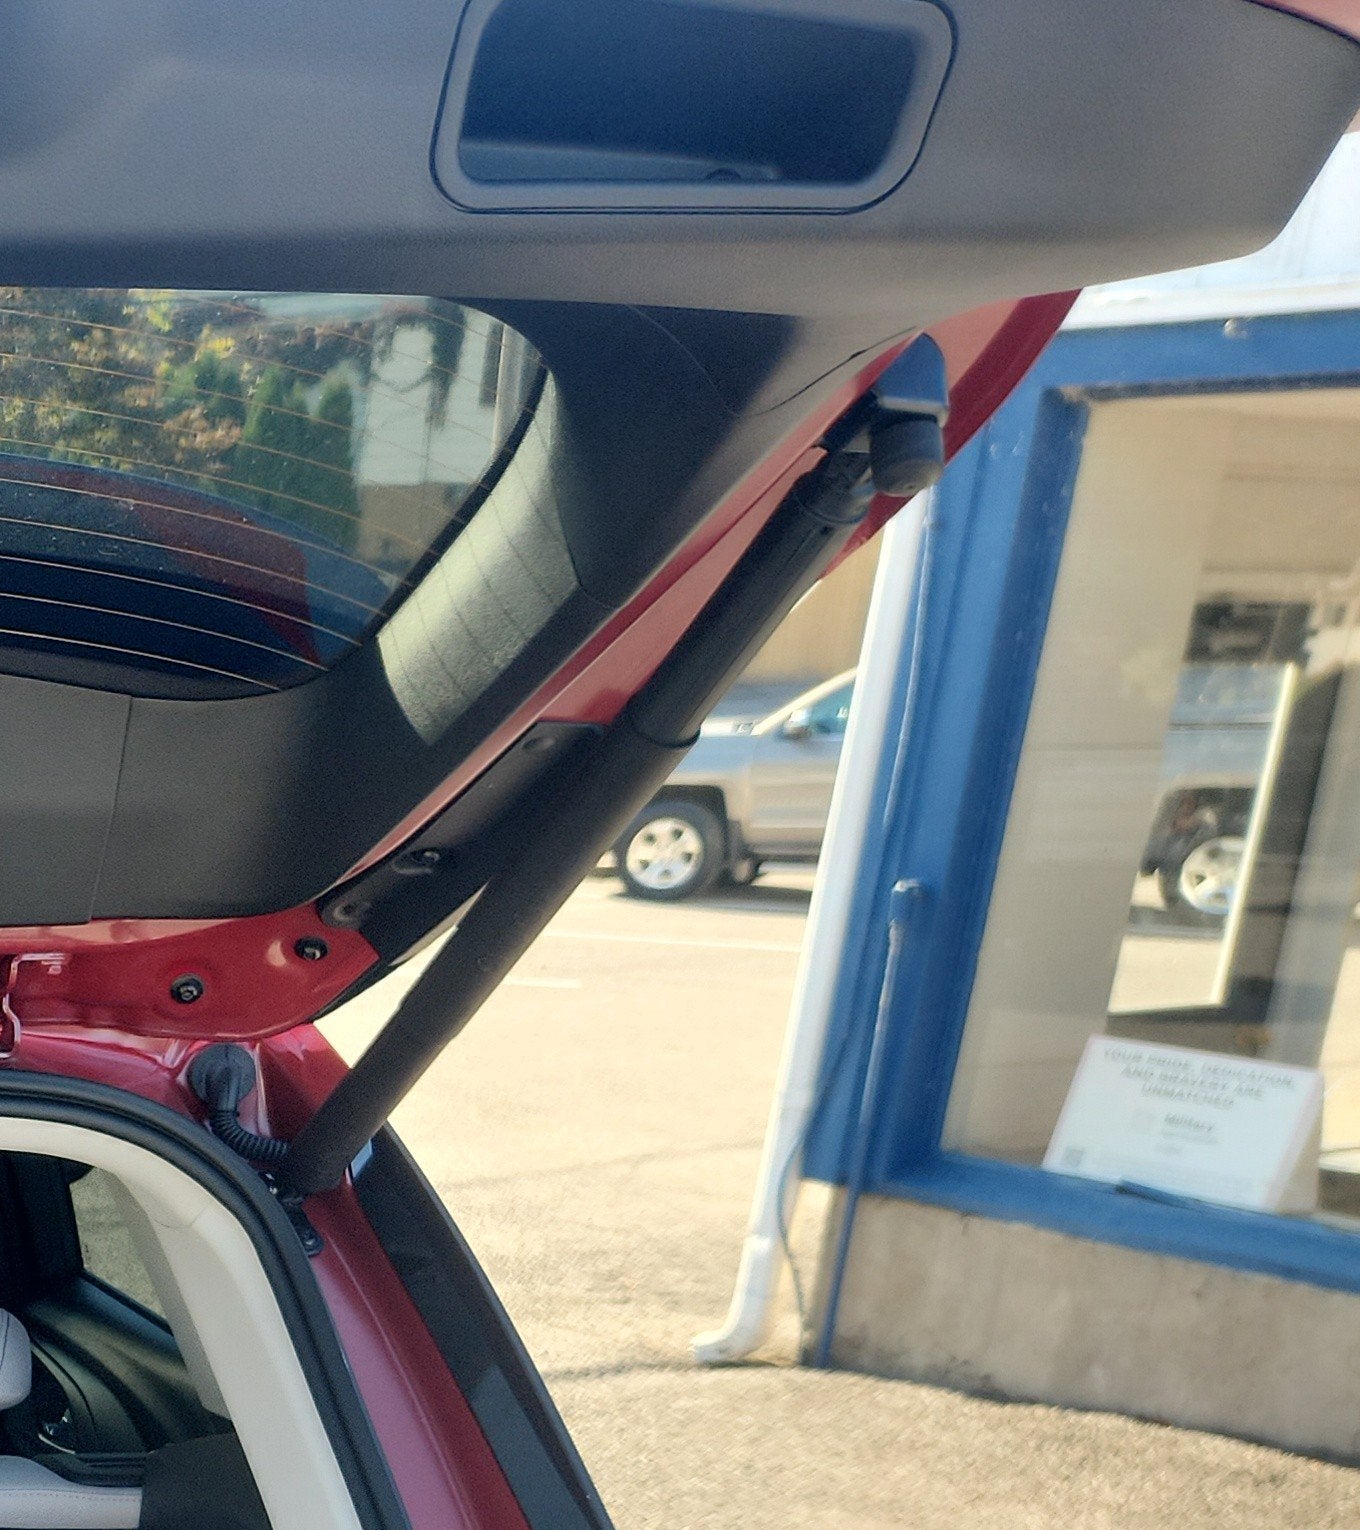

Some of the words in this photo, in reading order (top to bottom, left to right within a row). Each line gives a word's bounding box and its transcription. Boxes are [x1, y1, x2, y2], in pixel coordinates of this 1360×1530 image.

[1104, 1048, 1143, 1065] YOUR
[1120, 1064, 1155, 1082] AND
[1158, 1071, 1230, 1091] BRAVERY
[1233, 1082, 1268, 1101] ARE
